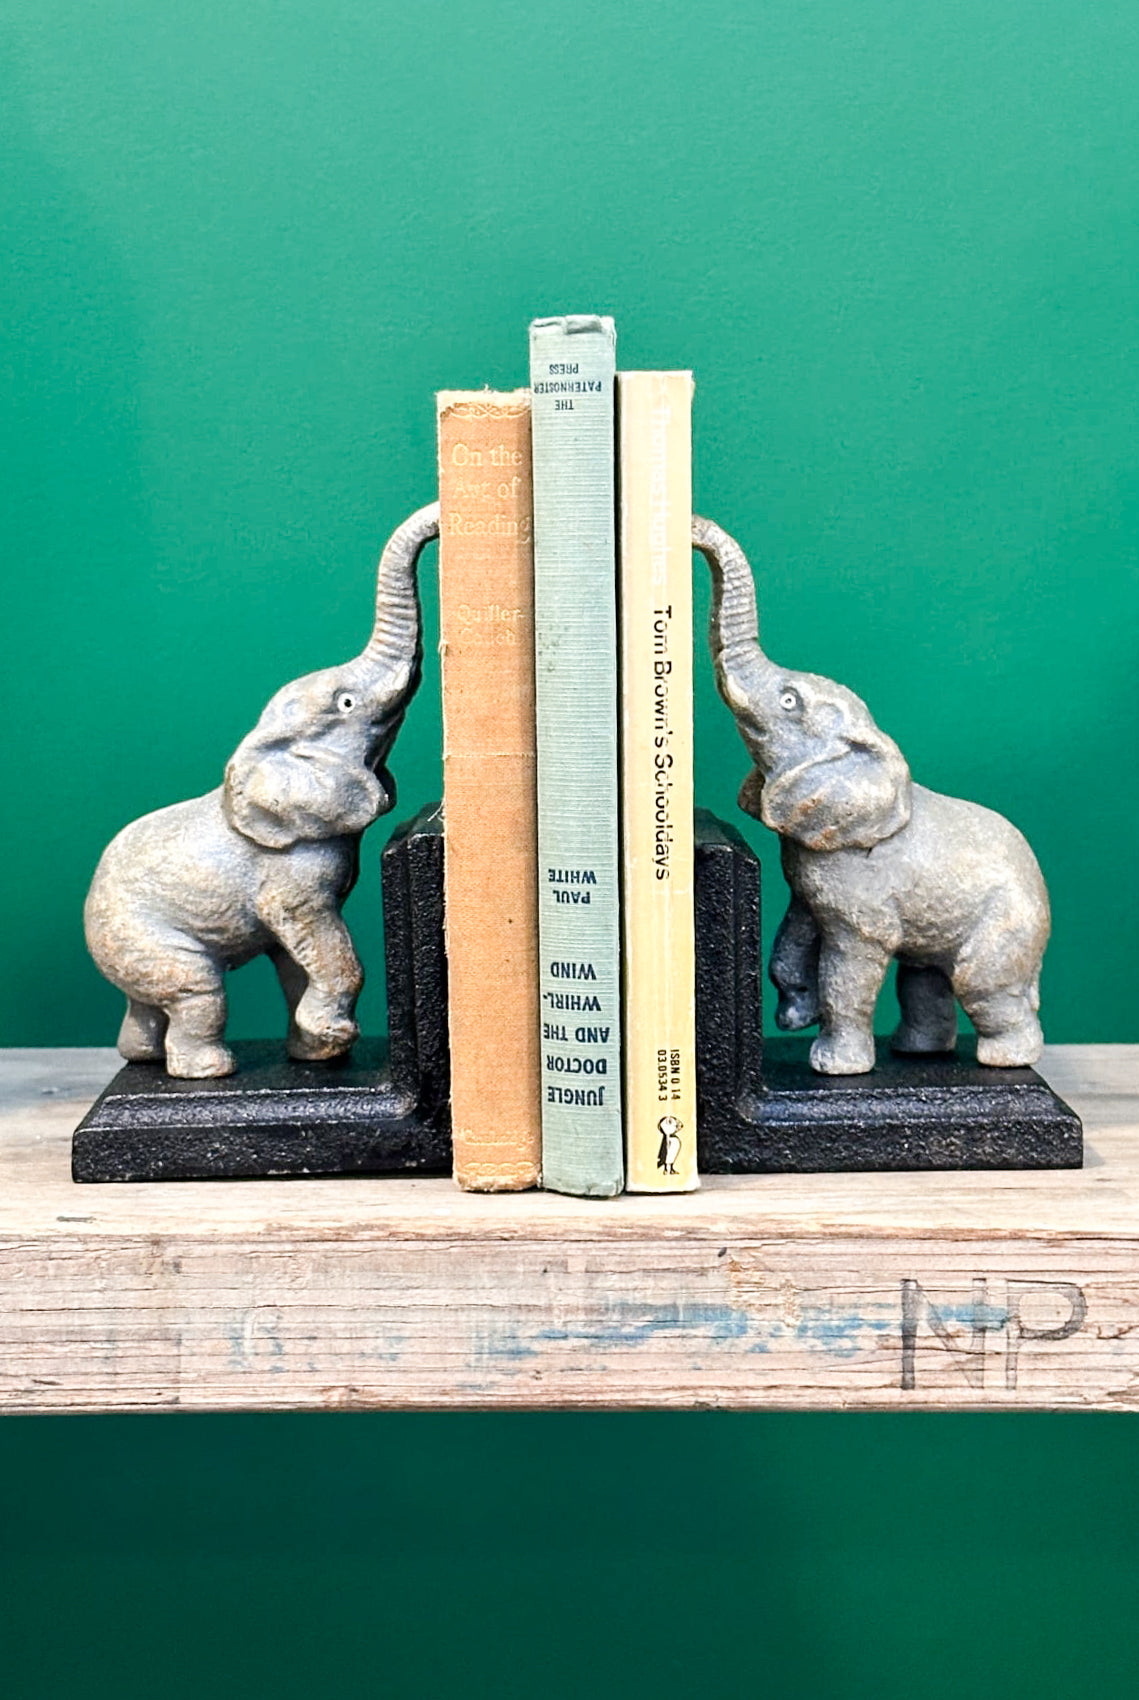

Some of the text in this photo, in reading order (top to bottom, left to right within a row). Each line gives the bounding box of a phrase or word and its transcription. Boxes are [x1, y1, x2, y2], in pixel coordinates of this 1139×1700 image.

[548, 363, 579, 375] PRESS
[533, 380, 602, 394] PATERNOSTER
[554, 399, 574, 411] THE
[451, 443, 523, 467] On the
[452, 476, 521, 498] Art of
[447, 511, 531, 545] Reading
[651, 605, 673, 880] Tom Brown's Schooldays
[548, 868, 597, 884] WHITE
[553, 890, 590, 904] PAUL
[550, 961, 597, 980] WIND
[542, 992, 602, 1012] WHIRL-
[543, 1022, 610, 1043] AND THE
[546, 1054, 607, 1074] DOCTOR
[670, 1049, 680, 1074] ISBN
[547, 1085, 605, 1106] JUNGLE
[671, 1088, 681, 1100] 14
